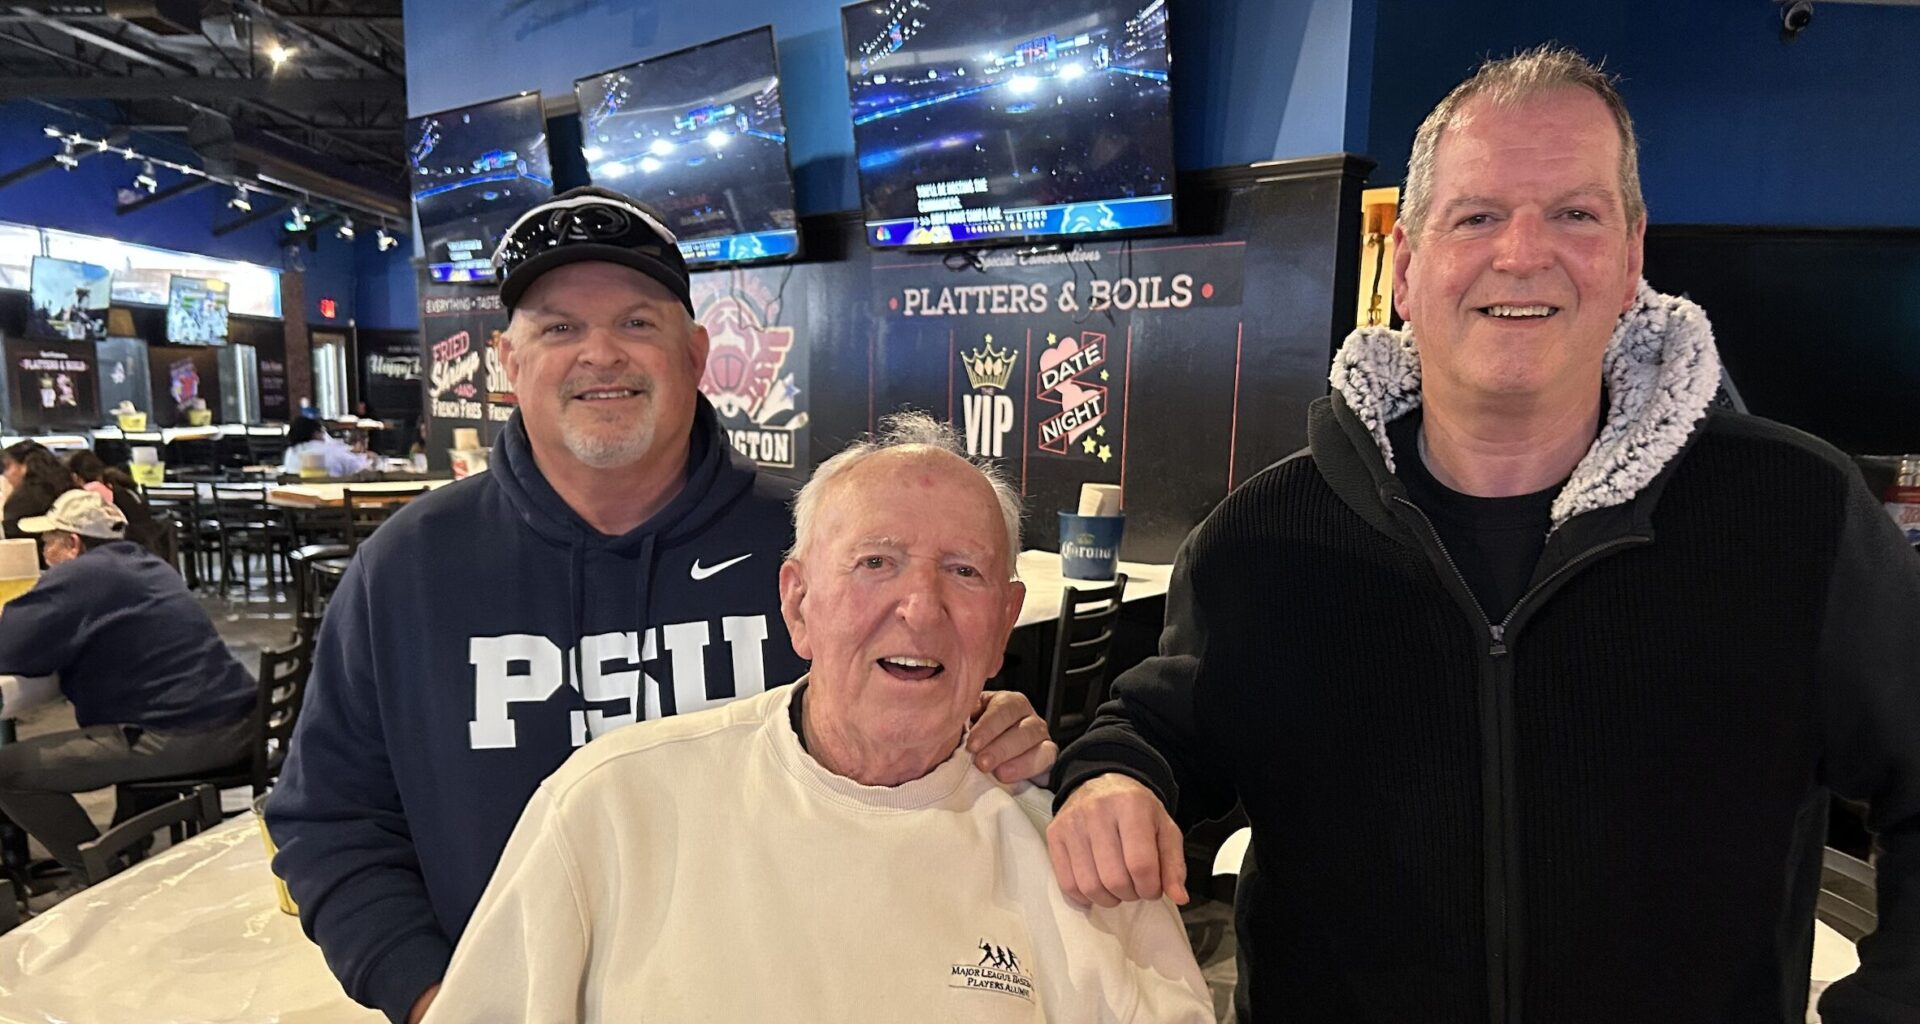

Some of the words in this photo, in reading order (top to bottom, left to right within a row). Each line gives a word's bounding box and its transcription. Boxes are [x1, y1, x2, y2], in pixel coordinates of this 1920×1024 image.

[425, 296, 471, 314] EVERYTHING
[902, 282, 1049, 316] PLATTERS
[1057, 280, 1079, 313] &
[1089, 273, 1194, 311] BOILS
[432, 330, 470, 362] FRIED
[1041, 343, 1101, 391] DATE
[428, 350, 480, 398] Shrimp
[962, 393, 1015, 458] VIP
[1041, 395, 1101, 443] NIGHT
[468, 614, 769, 750] PSU
[951, 966, 980, 977] MAJOR
[981, 969, 1011, 983] LEAGUE
[967, 977, 1004, 990] PLAYERS
